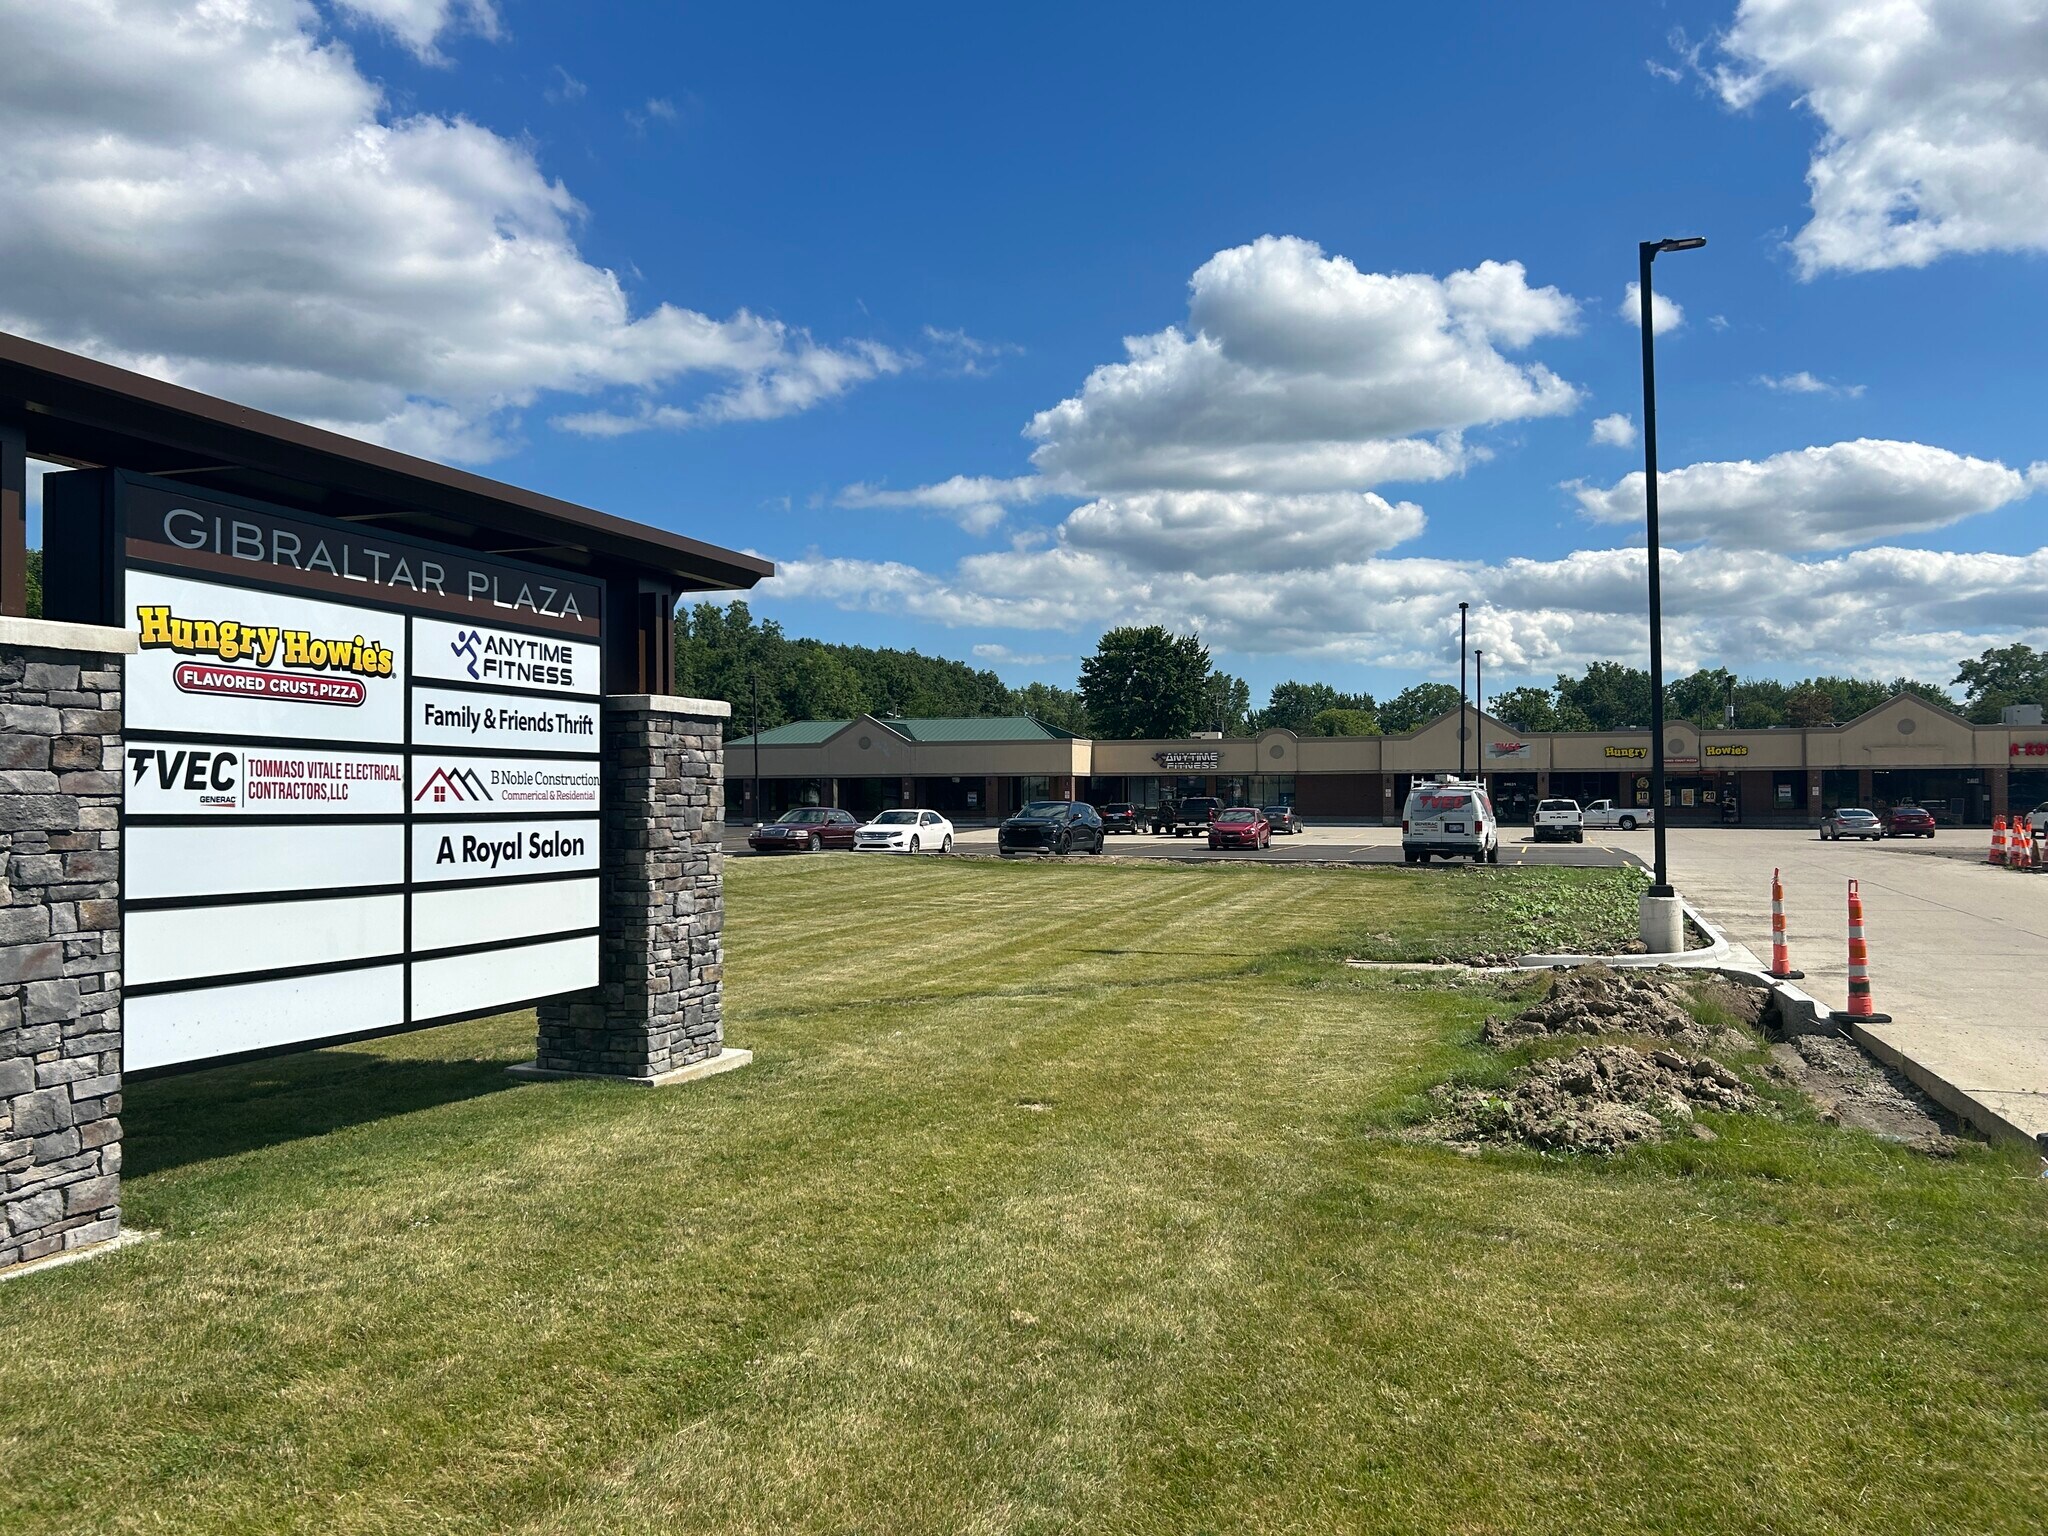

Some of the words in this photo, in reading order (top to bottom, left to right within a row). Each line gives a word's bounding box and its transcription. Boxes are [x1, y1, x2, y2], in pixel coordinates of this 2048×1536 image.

[163, 508, 445, 597] GIBRALTAR
[467, 571, 583, 622] PLAZA
[137, 606, 279, 667] Hungry
[283, 635, 395, 678] Howie's
[484, 635, 573, 664] ANYTIME
[483, 658, 574, 686] FITNESS
[183, 670, 266, 691] FLAVORED
[319, 685, 359, 700] PIZZA
[425, 703, 481, 734] Family
[484, 708, 496, 729] &
[500, 709, 554, 733] Friends
[556, 714, 594, 736] Thrift
[1166, 752, 1218, 761] ANYTIME
[1605, 746, 1648, 758] Hungry
[2025, 742, 2048, 756] RO
[127, 749, 238, 792] TVEC
[248, 759, 304, 779] TOMMASO
[307, 760, 342, 780] VITALE
[344, 763, 402, 782] ELECTRICAL
[1166, 762, 1218, 770] FITNESS
[491, 770, 500, 785] B
[501, 771, 533, 786] Noble
[535, 772, 600, 786] Construction
[200, 795, 236, 804] GENERAC
[502, 790, 548, 801] Commerical
[549, 791, 555, 801] &
[556, 790, 595, 801] Residential
[1420, 795, 1465, 809] TVEC
[1705, 792, 1715, 800] 20
[436, 836, 456, 864] A
[463, 831, 523, 869] Royal
[529, 830, 584, 859] Salon
